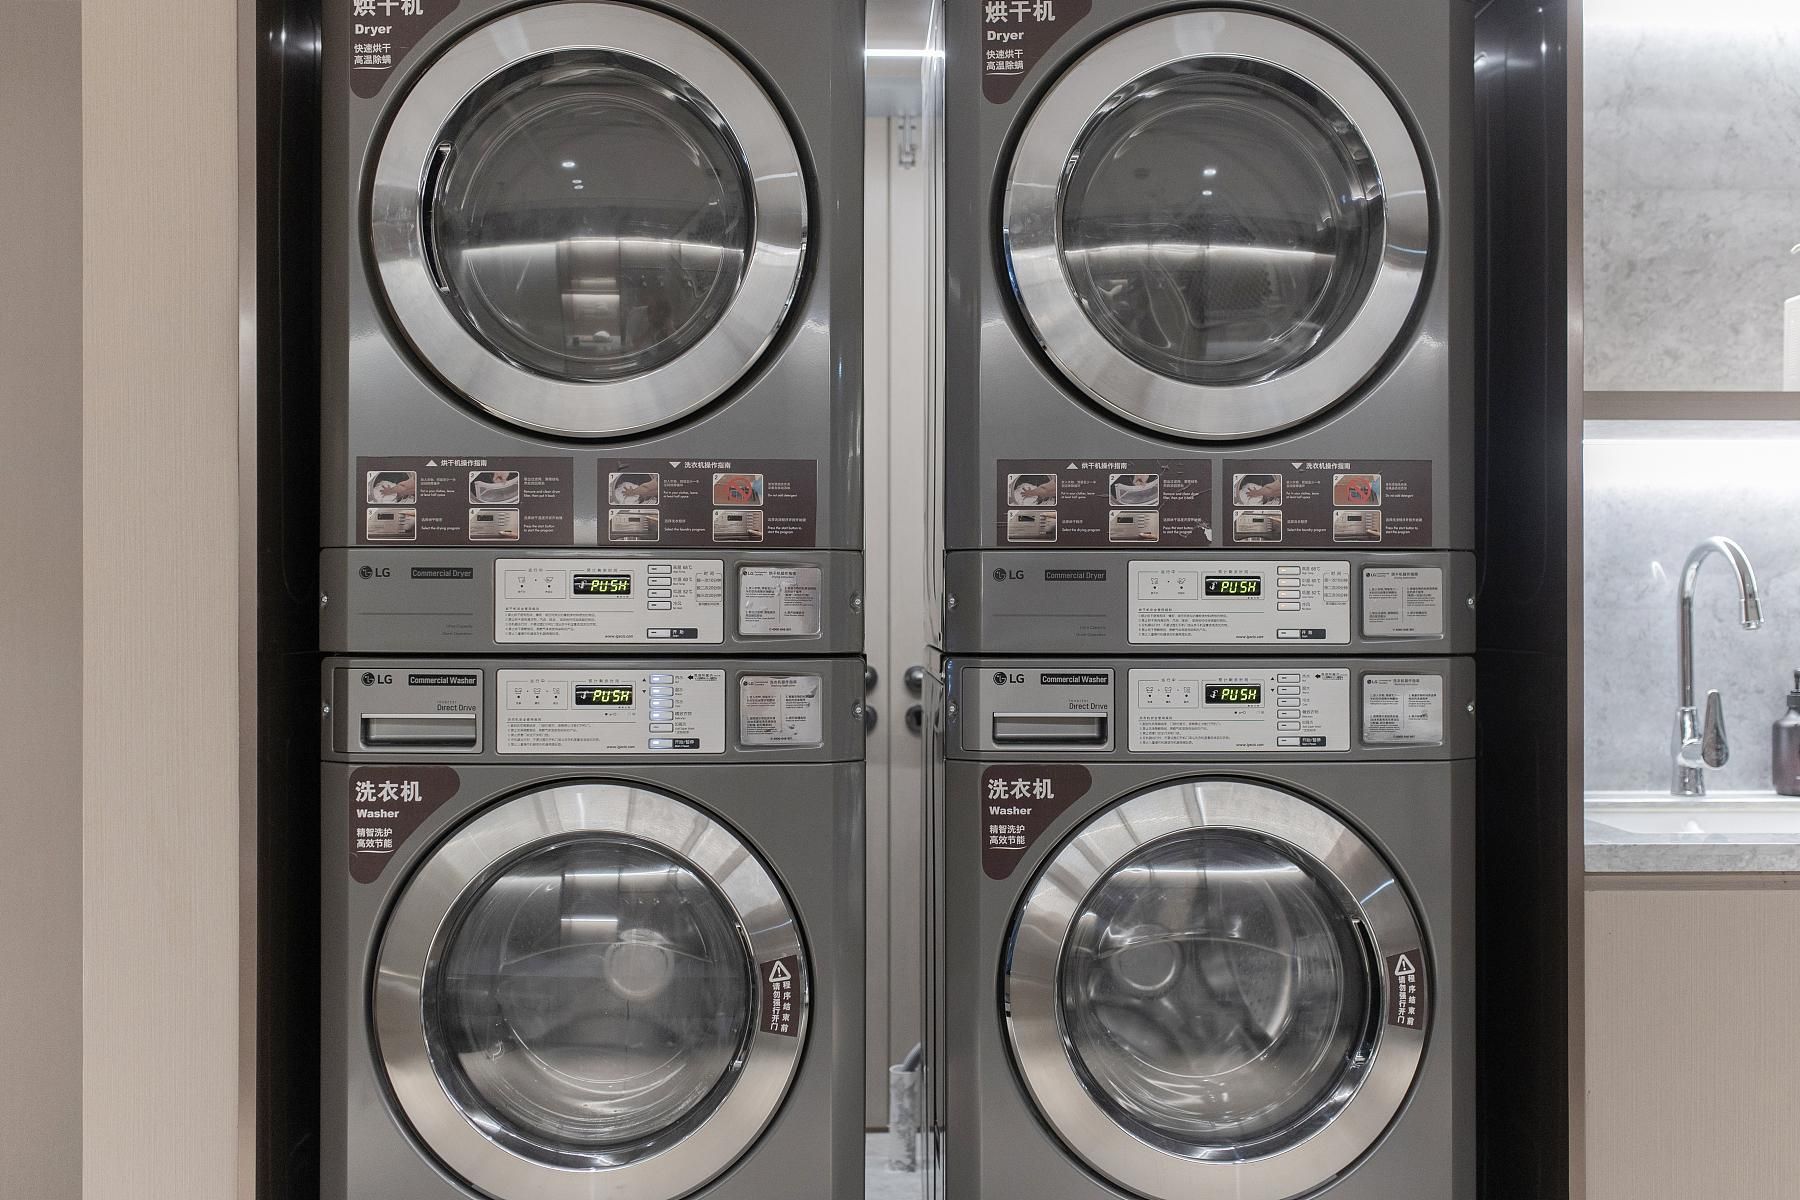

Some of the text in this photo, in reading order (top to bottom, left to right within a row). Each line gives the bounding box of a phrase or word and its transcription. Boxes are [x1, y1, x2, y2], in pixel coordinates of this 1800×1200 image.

[353, 0, 424, 16] 烘干机
[985, 0, 1056, 23] 烘干机
[354, 24, 392, 36] Dryer
[986, 30, 1024, 42] Dryer
[354, 44, 391, 54] 快速烘干
[986, 49, 1024, 59] 快速烘干
[354, 54, 392, 65] 高温除螨
[986, 60, 1024, 70] 高温除螨
[376, 568, 391, 578] LG
[453, 570, 471, 578] Dryer
[1009, 570, 1024, 580] LG
[1086, 572, 1104, 580] Dryer
[590, 580, 628, 592] PUSH
[1220, 581, 1257, 593] PUSH
[378, 675, 393, 684] LG
[1010, 674, 1025, 684] LG
[592, 690, 630, 702] PUSH
[1221, 689, 1257, 700] PUSH
[355, 780, 422, 802] 洗衣机
[987, 778, 1055, 800] 洗衣机
[356, 809, 399, 818] Washer
[989, 806, 1032, 815] Washer
[356, 828, 392, 837] 精智洗护
[989, 824, 1025, 834] 精智洗护
[356, 838, 392, 848] 高效节能
[989, 835, 1025, 845] 高效节能
[770, 982, 780, 1031] 请勿强行开门
[781, 981, 791, 1032] 程序结束前
